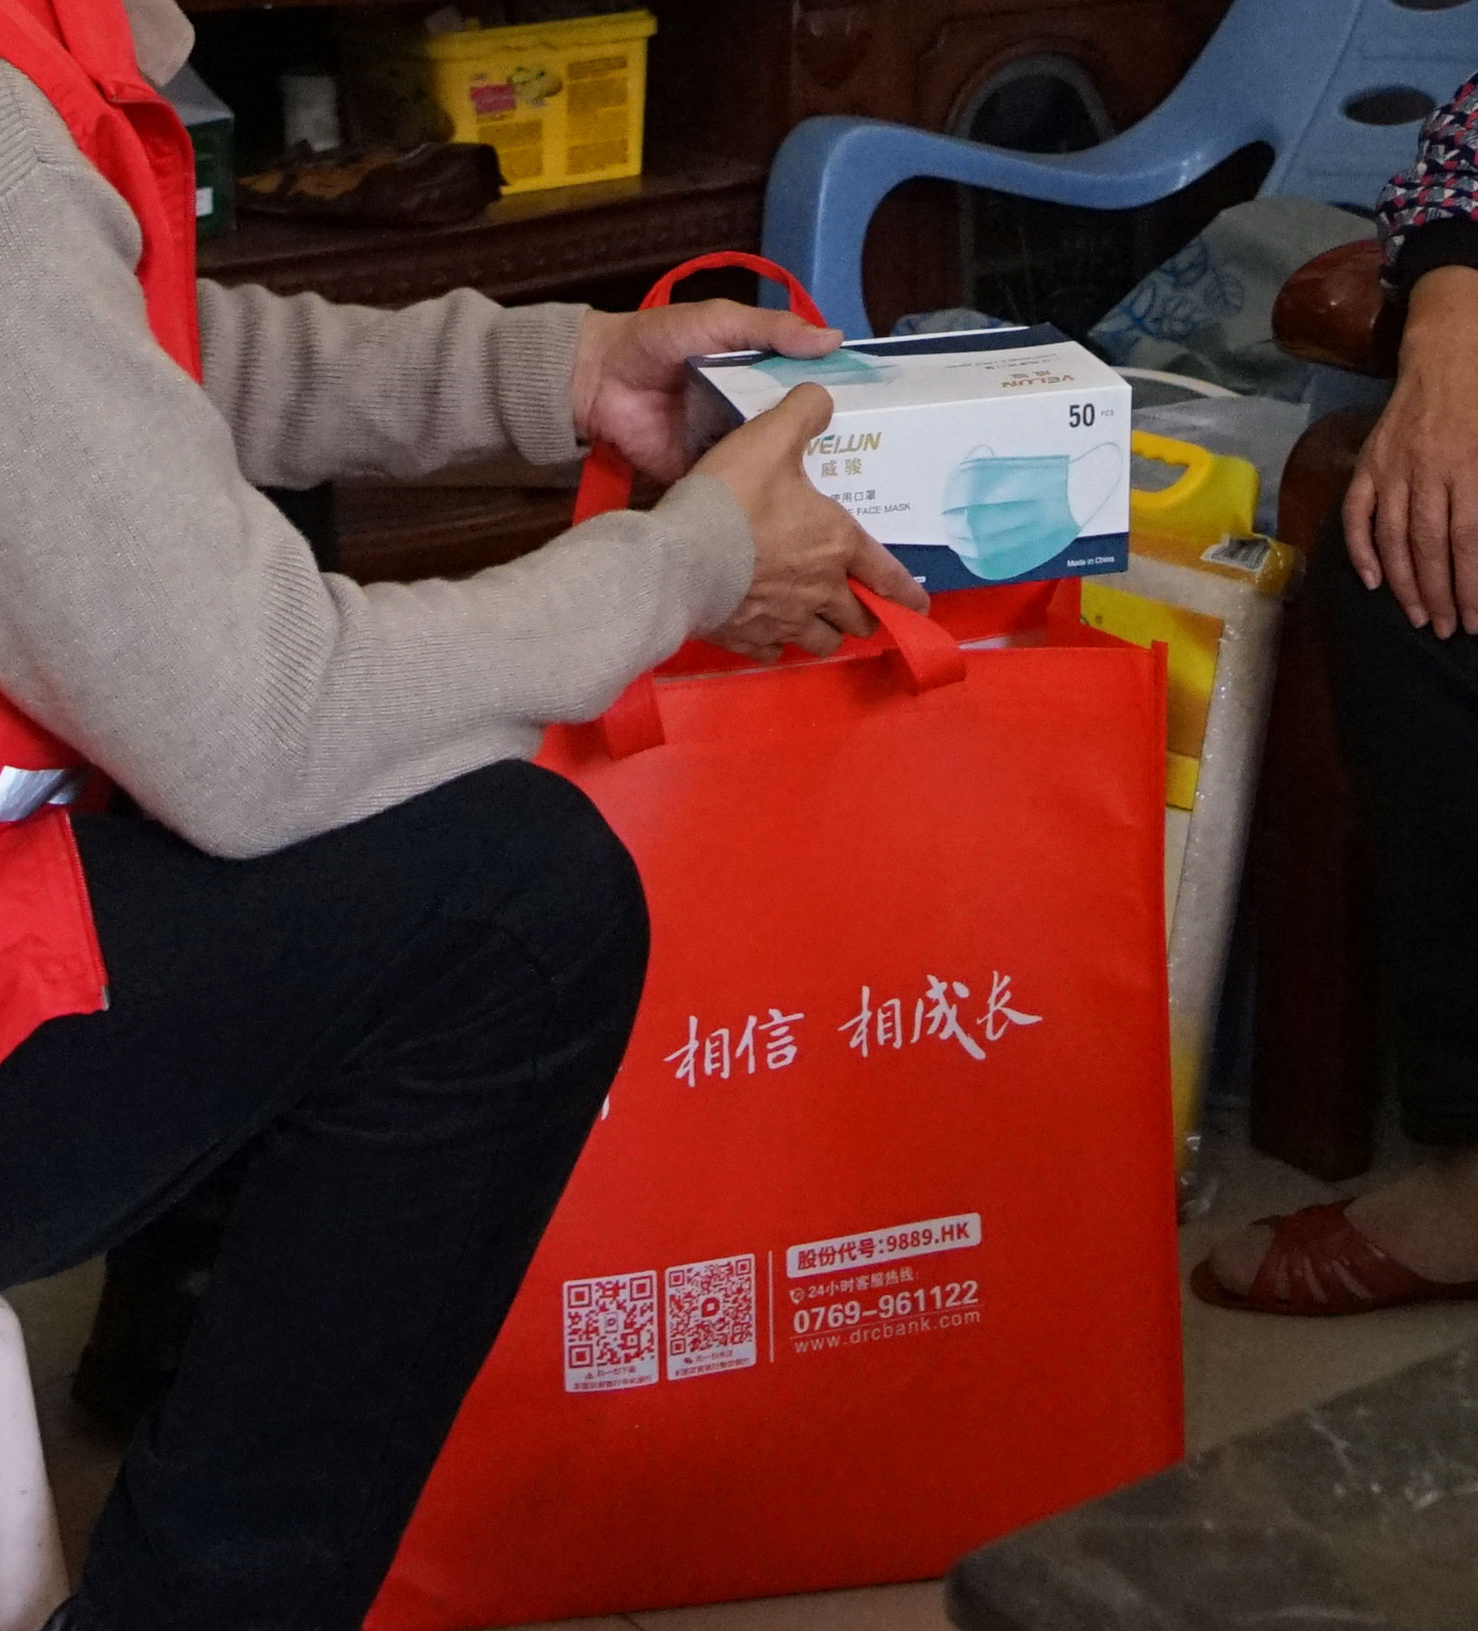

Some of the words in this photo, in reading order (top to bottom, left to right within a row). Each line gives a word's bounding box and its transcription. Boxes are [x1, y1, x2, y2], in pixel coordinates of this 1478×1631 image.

[1068, 402, 1096, 428] 50
[856, 506, 881, 515] FACE
[884, 502, 911, 513] MASK
[793, 1279, 980, 1334] 0769-961122
[795, 1309, 982, 1354] www.drcbank.com
